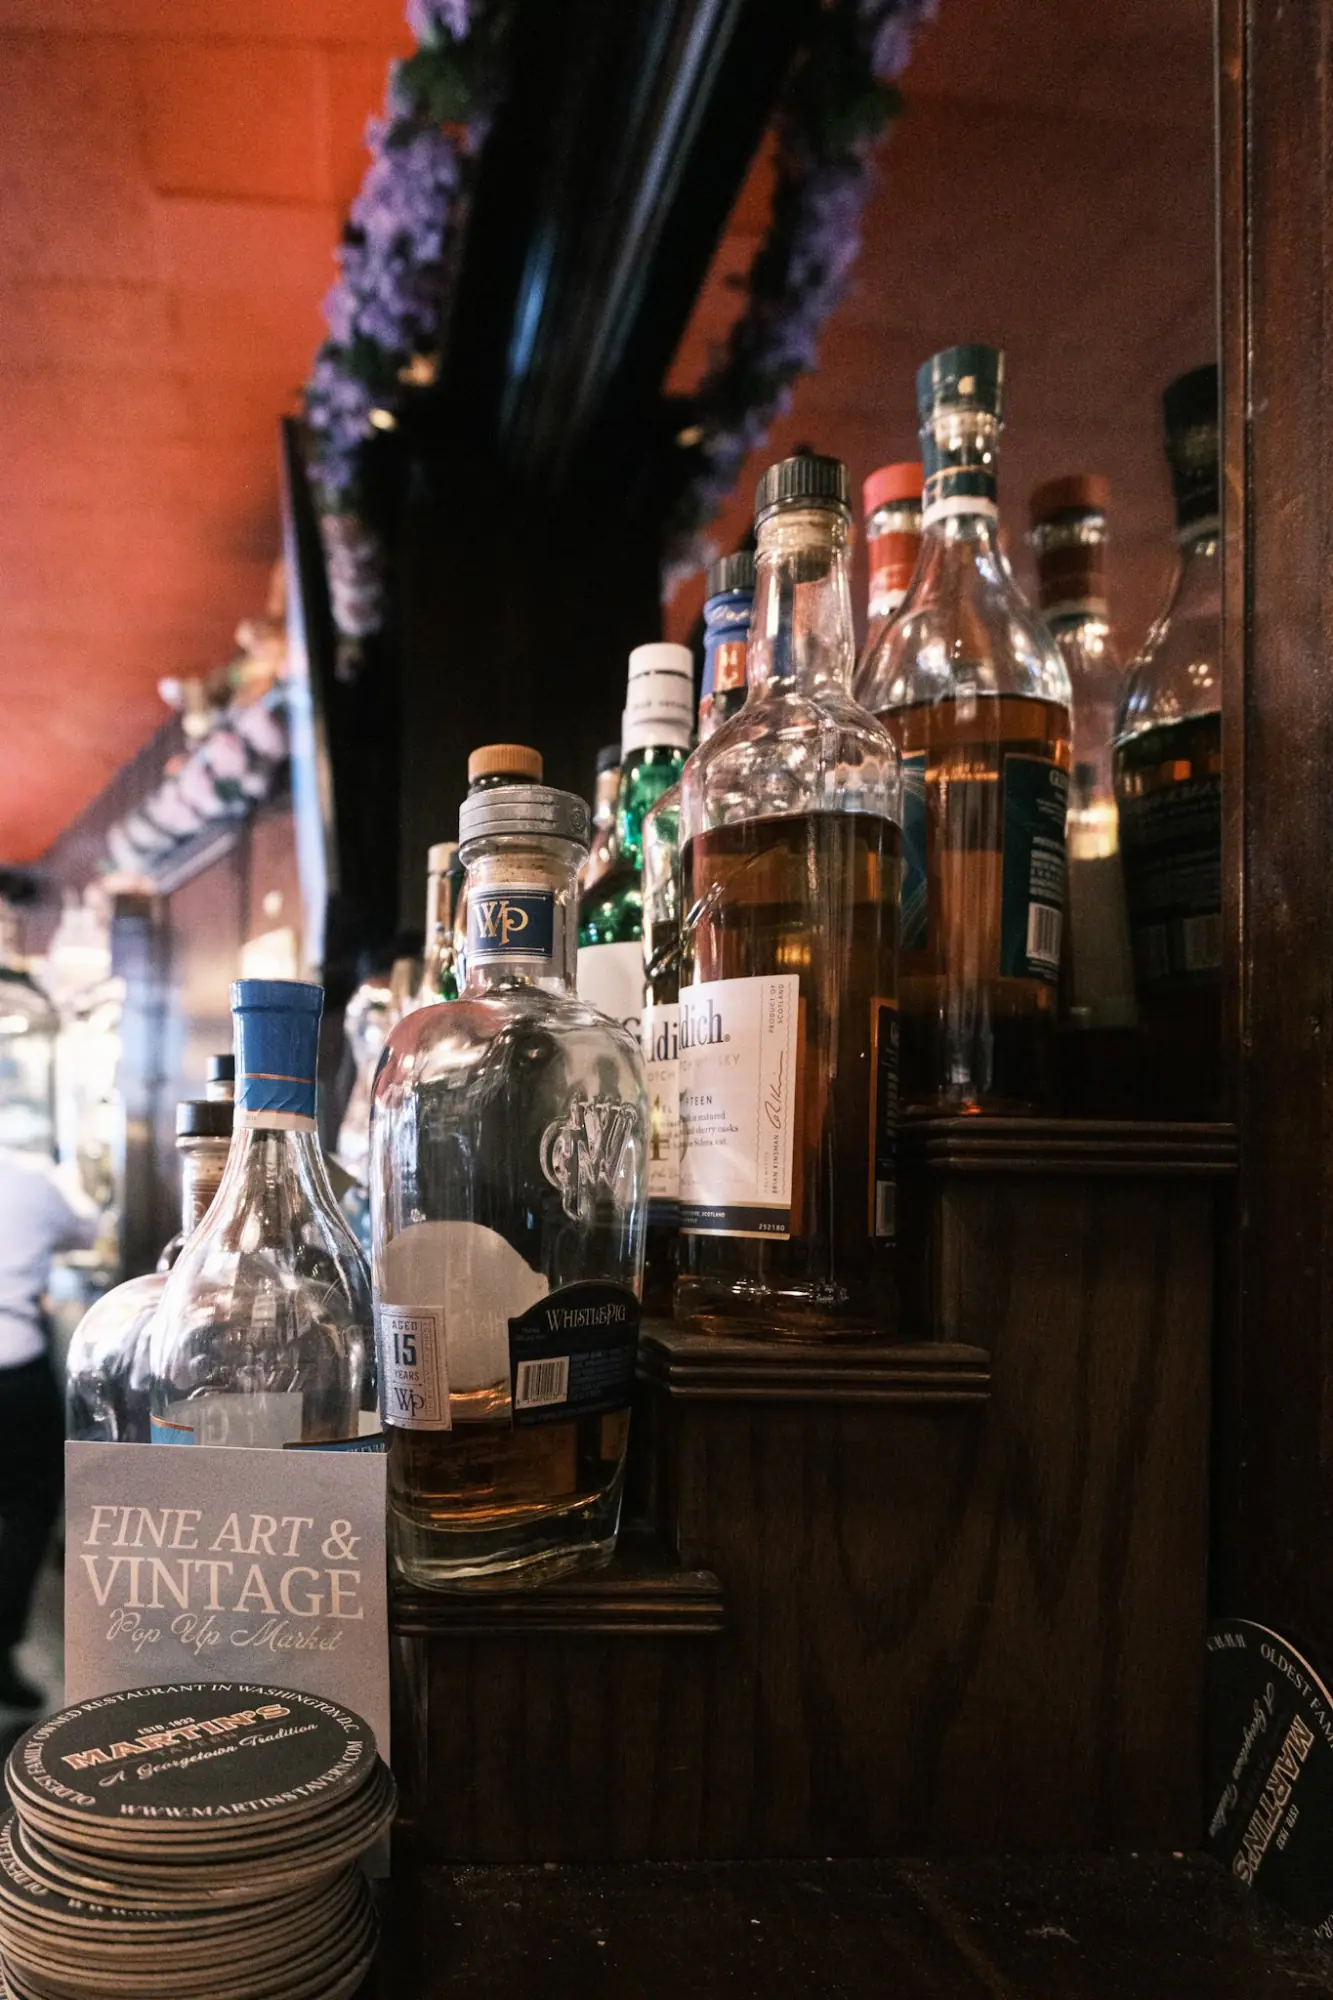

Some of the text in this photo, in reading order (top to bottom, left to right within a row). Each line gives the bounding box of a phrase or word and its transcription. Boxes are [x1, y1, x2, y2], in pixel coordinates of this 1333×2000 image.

[472, 900, 529, 946] WP
[392, 1320, 418, 1331] AGED
[393, 1333, 417, 1366] 15
[393, 1369, 420, 1381] YEARS
[83, 1505, 362, 1561] FINE ART &
[79, 1554, 364, 1620] VINTAGE
[106, 1608, 344, 1655] Pop Up Market
[1260, 1643, 1312, 1697] OLDEST
[81, 1684, 206, 1711] RESTAURANT
[239, 1684, 342, 1719] WASHINGTON
[33, 1709, 82, 1740] OWNED
[61, 1704, 291, 1770] MARTIN'S
[24, 1741, 46, 1775] FAMILY
[98, 1723, 318, 1787] A Georgetown Tradition
[32, 1775, 96, 1806] OLDEST
[120, 1740, 364, 1818] WWW.MARTINSTAVERN.COM
[1233, 1714, 1314, 1887] MARTIN'S
